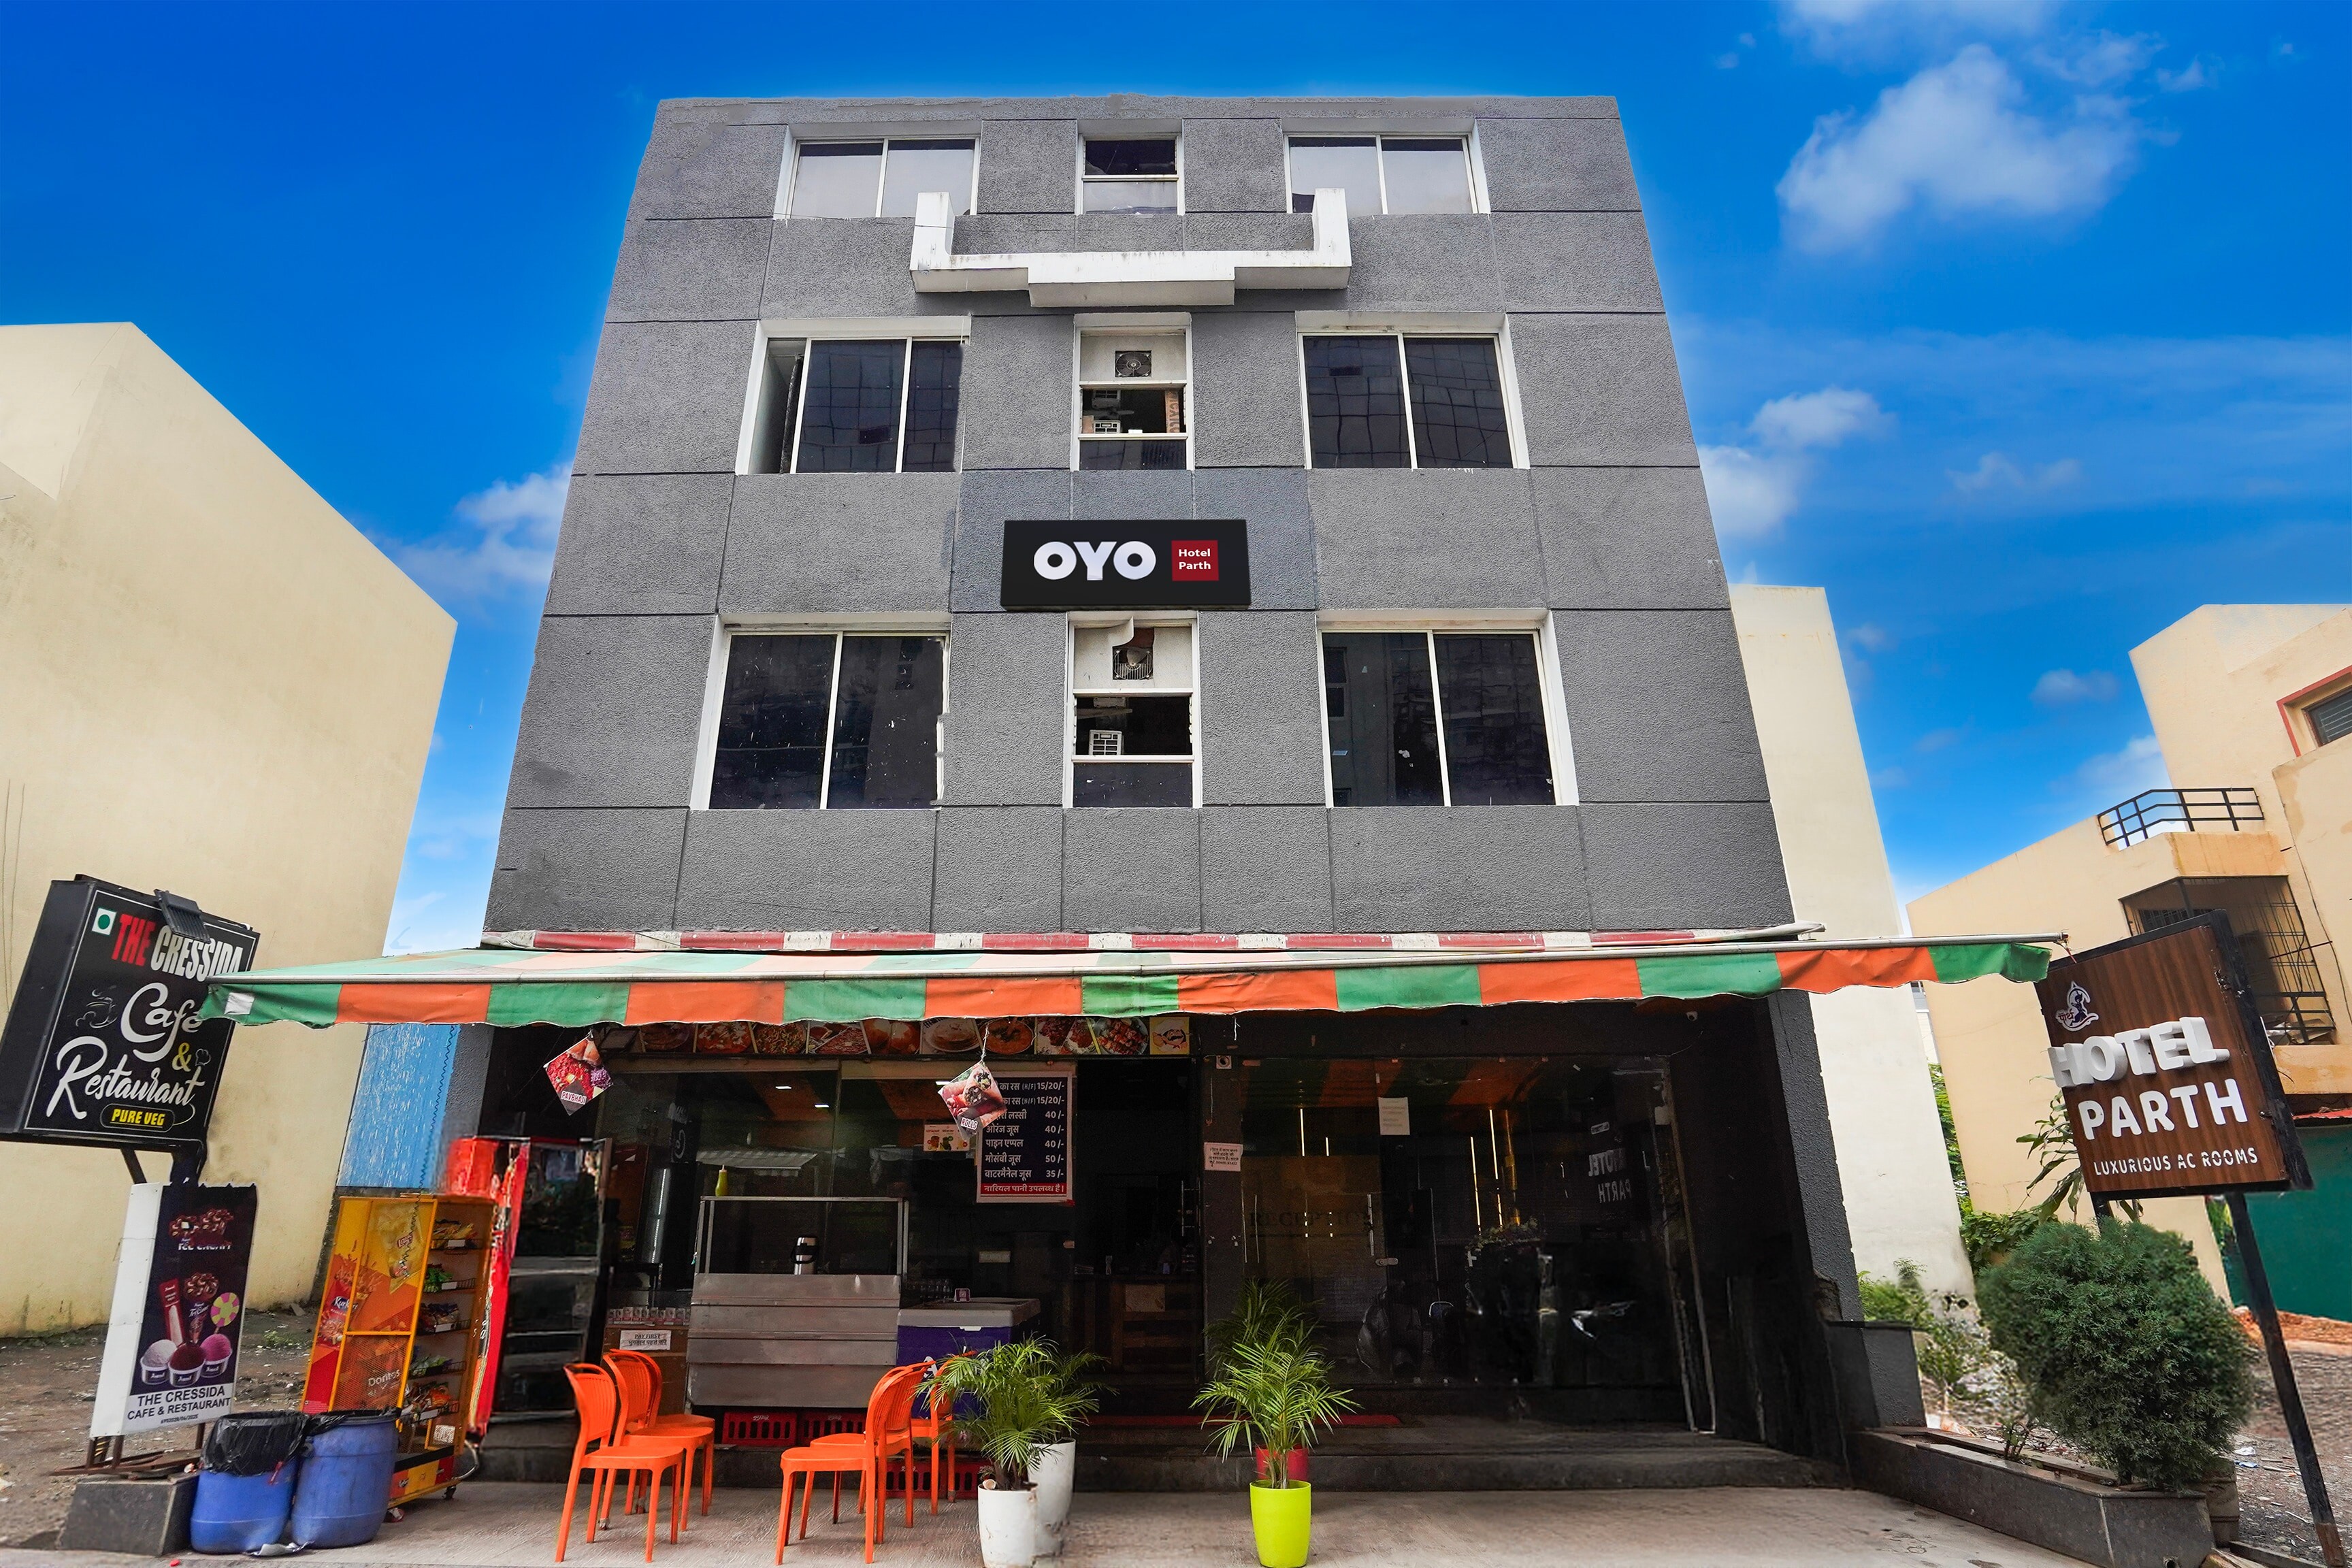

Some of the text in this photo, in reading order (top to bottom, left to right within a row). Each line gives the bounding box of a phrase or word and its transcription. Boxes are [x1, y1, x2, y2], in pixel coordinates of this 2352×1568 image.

[1034, 541, 1156, 581] OYO
[1178, 549, 1211, 557] Hotel
[1178, 561, 1211, 570] Parth
[112, 913, 244, 981] THE CRESSIDA
[172, 1042, 192, 1072] &
[2047, 1016, 2230, 1088] HOTEL
[46, 1036, 206, 1120] Restaurant
[1036, 1081, 1065, 1091] 15/20/-
[561, 1091, 587, 1105] PAVBHAJI
[1037, 1096, 1064, 1105] 15/20/-
[111, 1108, 166, 1126] PURE VEG
[2078, 1078, 2248, 1140] PARTH
[961, 1117, 978, 1130] ROLLS
[2093, 1147, 2259, 1176] LUXURIOUS AC ROOMS
[368, 1369, 400, 1386] Doritos
[137, 1386, 225, 1407] THE CRESSIDA
[127, 1407, 155, 1420] CAFE
[157, 1406, 165, 1415] &
[167, 1397, 231, 1414] RESTAURANT
